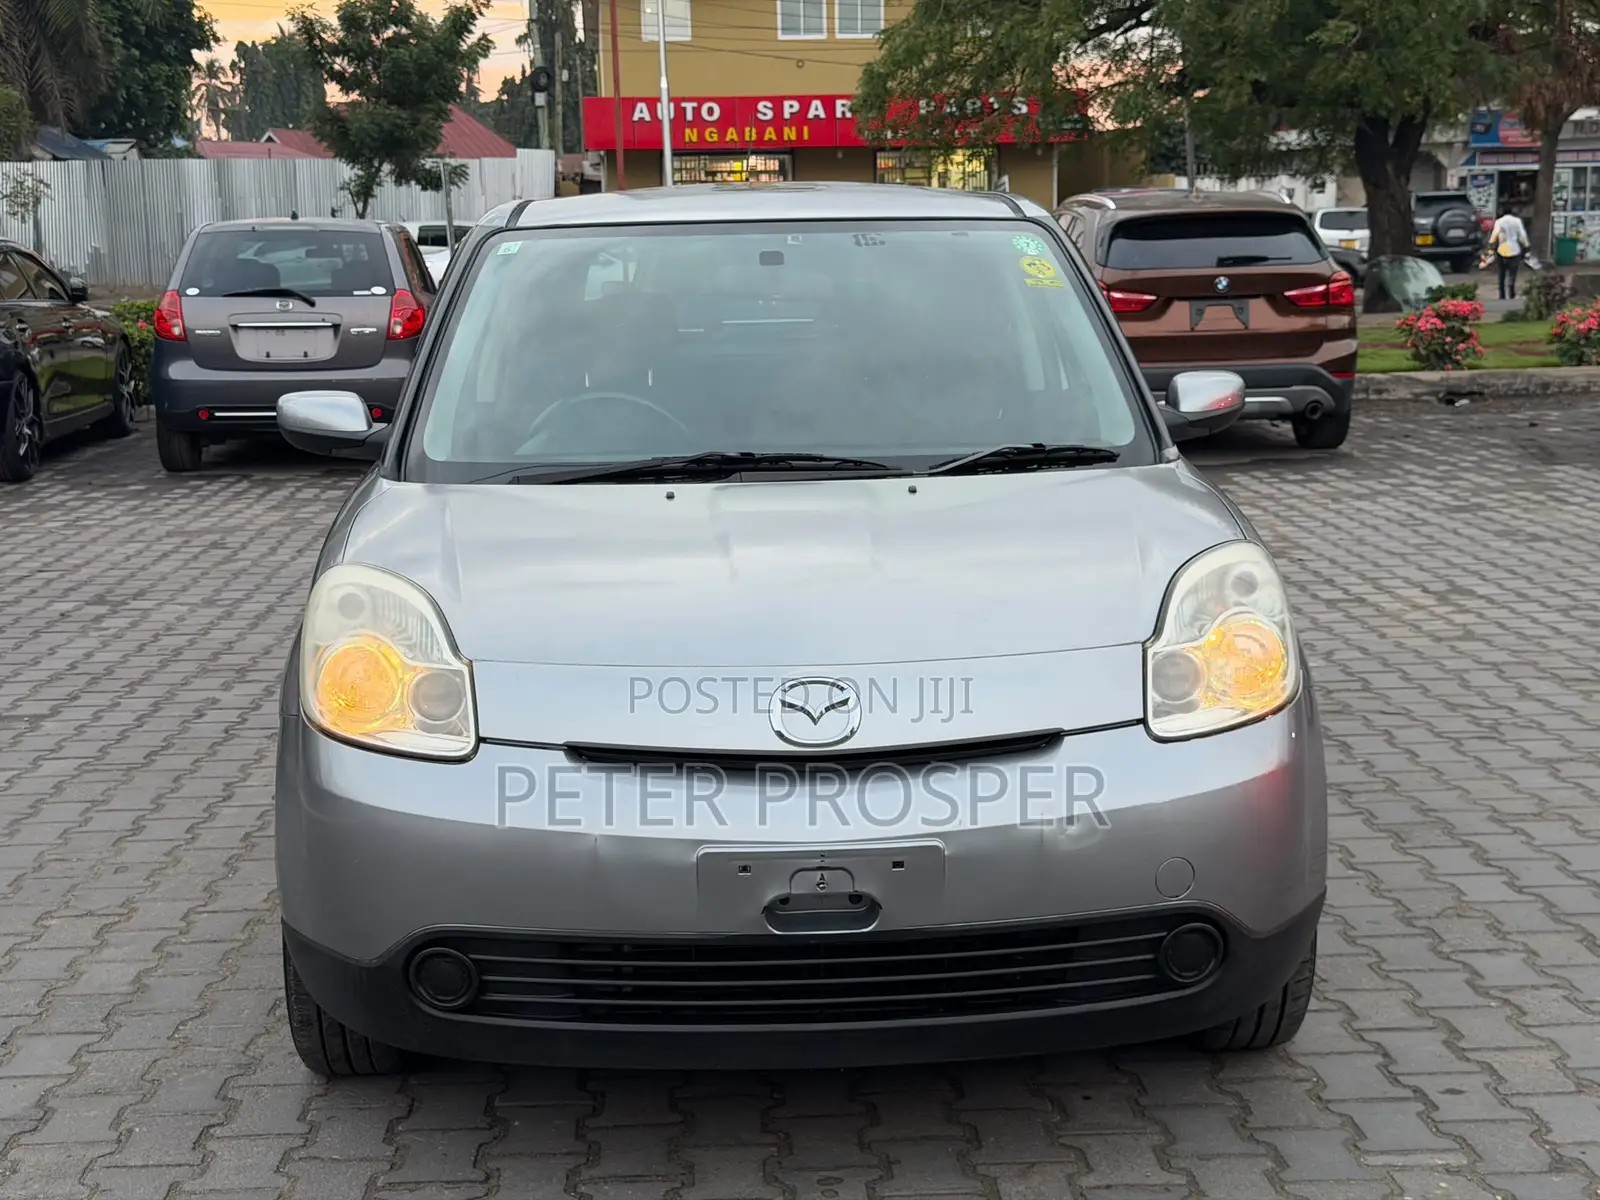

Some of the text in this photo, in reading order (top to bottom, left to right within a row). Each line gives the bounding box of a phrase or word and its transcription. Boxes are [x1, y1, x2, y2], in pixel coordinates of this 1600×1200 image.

[632, 102, 720, 122] AUTO
[756, 99, 853, 121] SPAR
[684, 126, 809, 142] NGABANI
